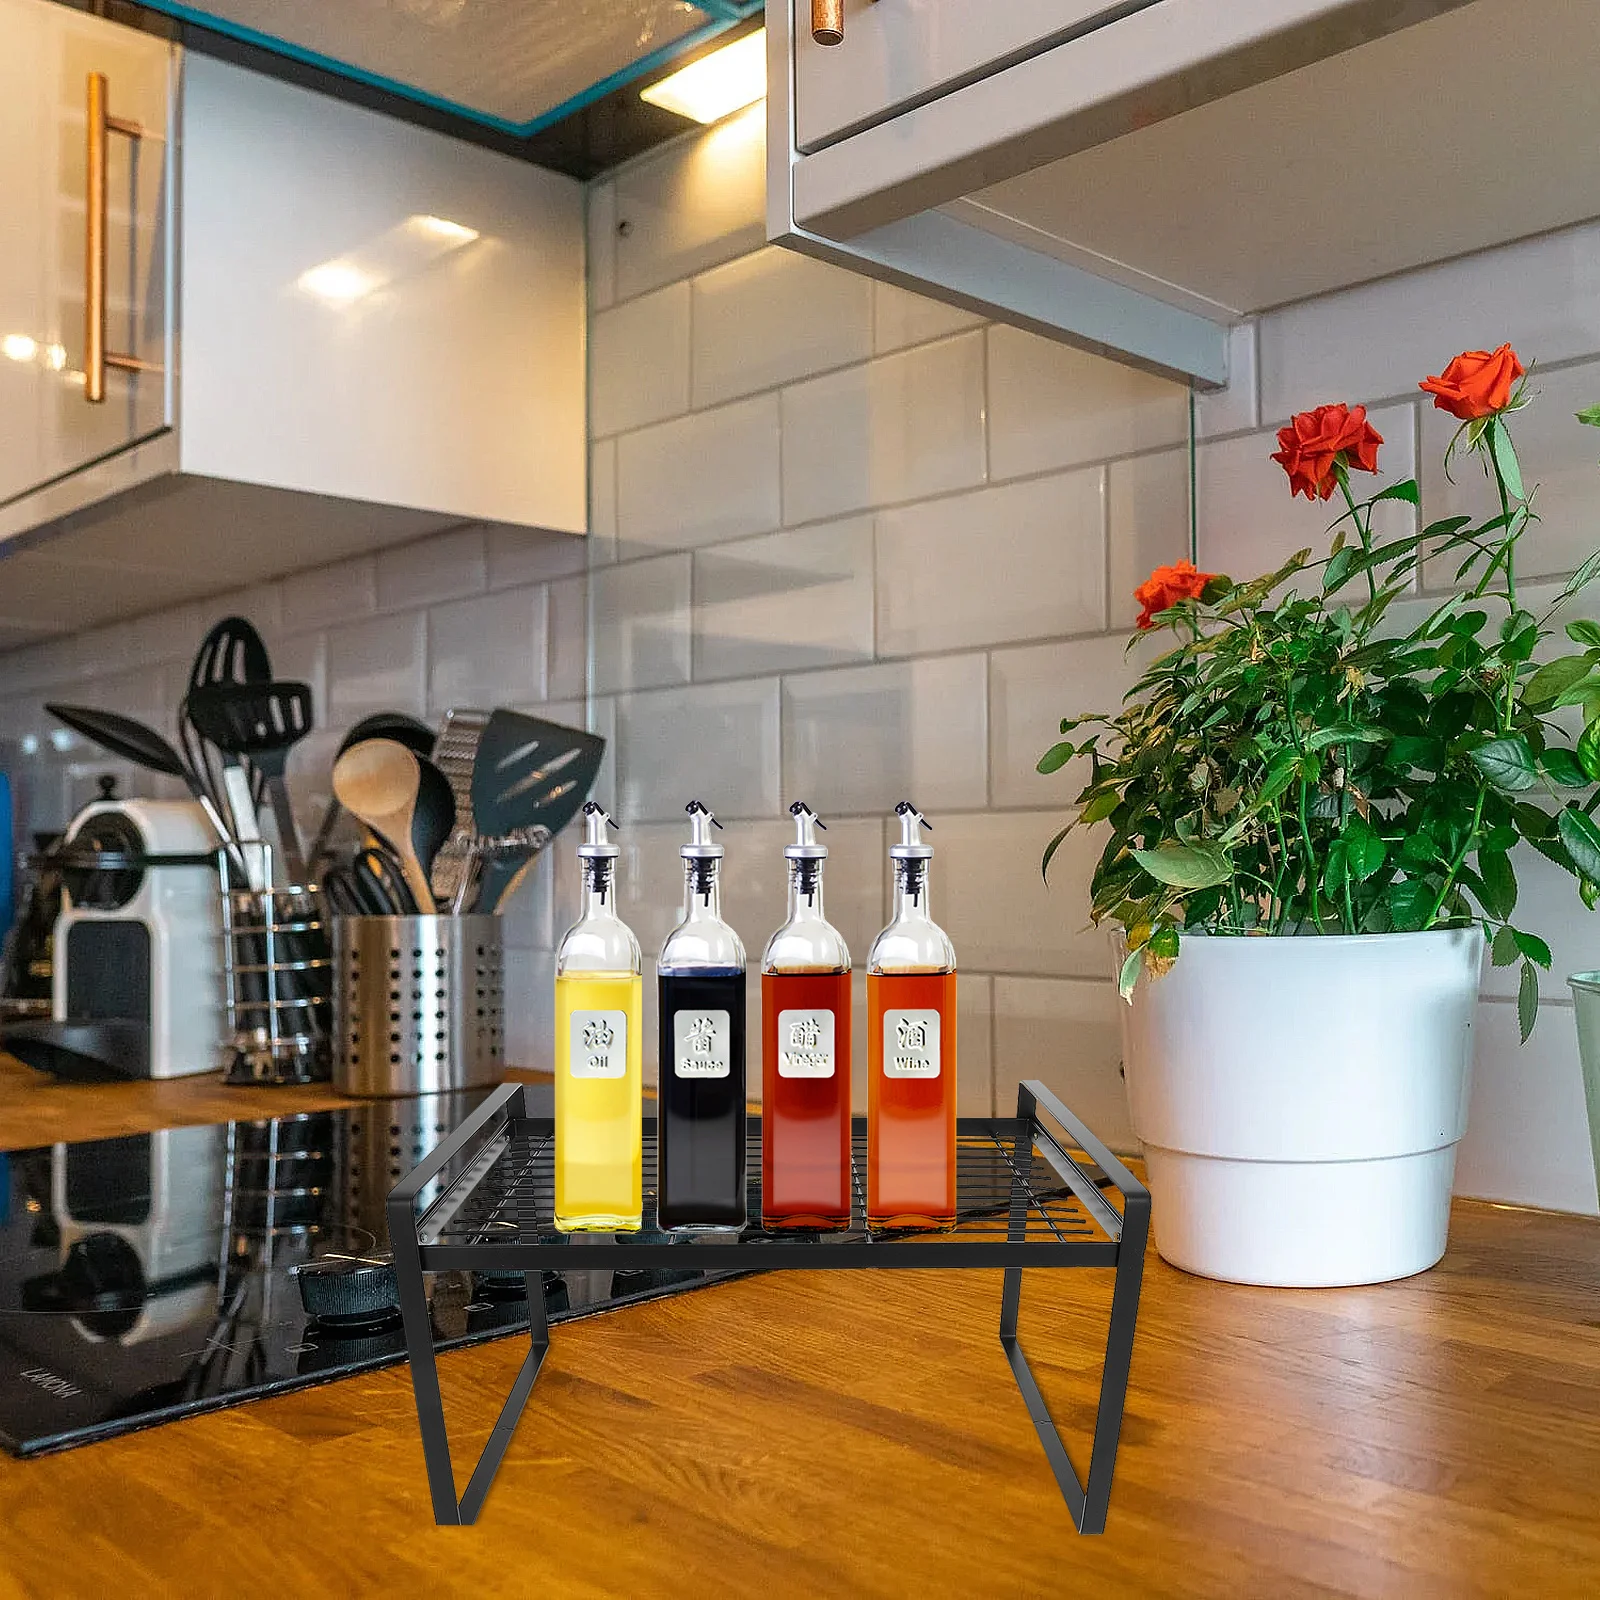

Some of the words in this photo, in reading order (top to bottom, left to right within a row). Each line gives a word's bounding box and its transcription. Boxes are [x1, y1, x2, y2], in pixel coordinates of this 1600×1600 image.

[582, 1018, 615, 1051] 油
[790, 1018, 821, 1049] 醋
[896, 1017, 928, 1051] 酒
[587, 1055, 609, 1069] Oil
[681, 1058, 724, 1071] Sauce
[894, 1056, 931, 1070] Wine
